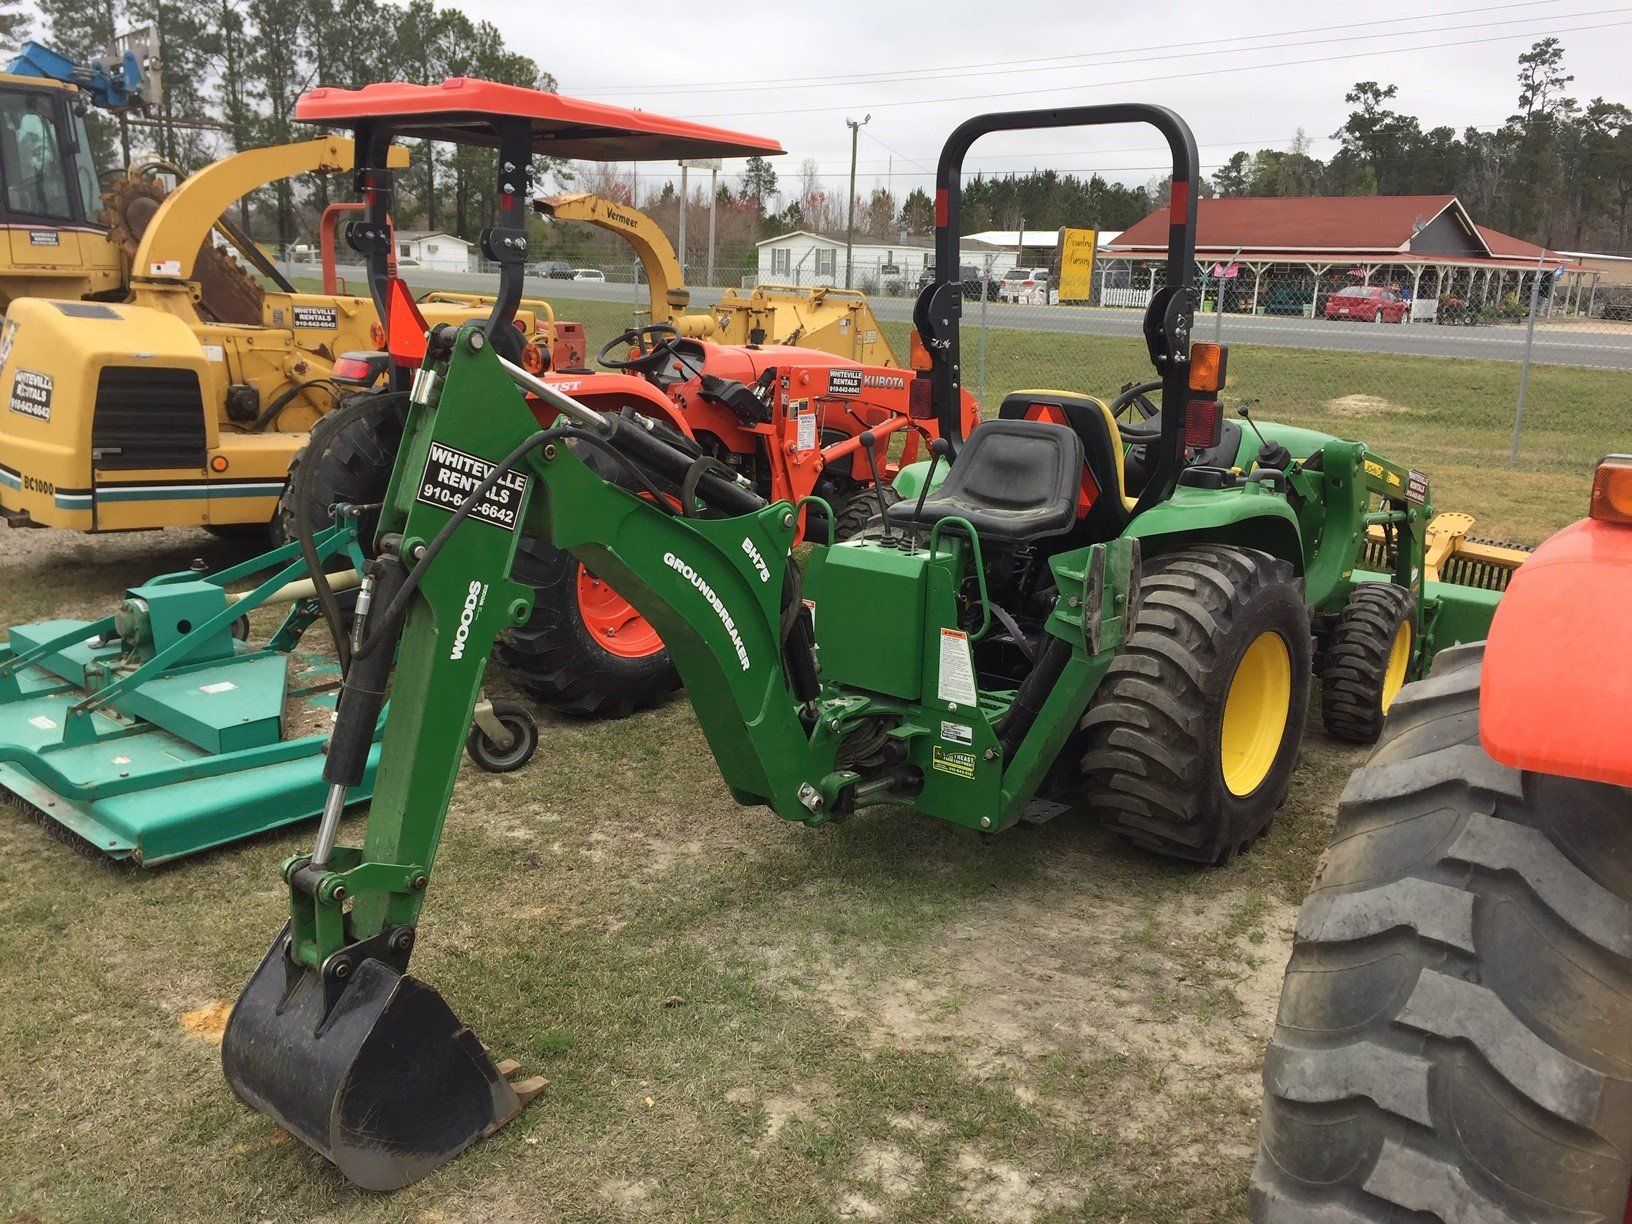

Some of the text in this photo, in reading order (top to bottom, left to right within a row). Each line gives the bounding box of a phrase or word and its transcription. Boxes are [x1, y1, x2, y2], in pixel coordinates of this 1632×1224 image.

[606, 206, 638, 228] Vermeer
[1065, 229, 1092, 252] Country
[1064, 249, 1090, 270] Nursery
[294, 307, 336, 315] WHITEVILLE
[830, 370, 862, 378] WHITEVILLE
[833, 378, 858, 386] RENTALS
[864, 375, 904, 389] KUBOTA
[24, 475, 54, 496] BC1000
[437, 467, 510, 504] RENTLS
[423, 483, 514, 523] 910-6-6642
[741, 536, 771, 583] BH75
[450, 580, 482, 660] WOODS
[663, 552, 751, 672] GROUNDBREAKER
